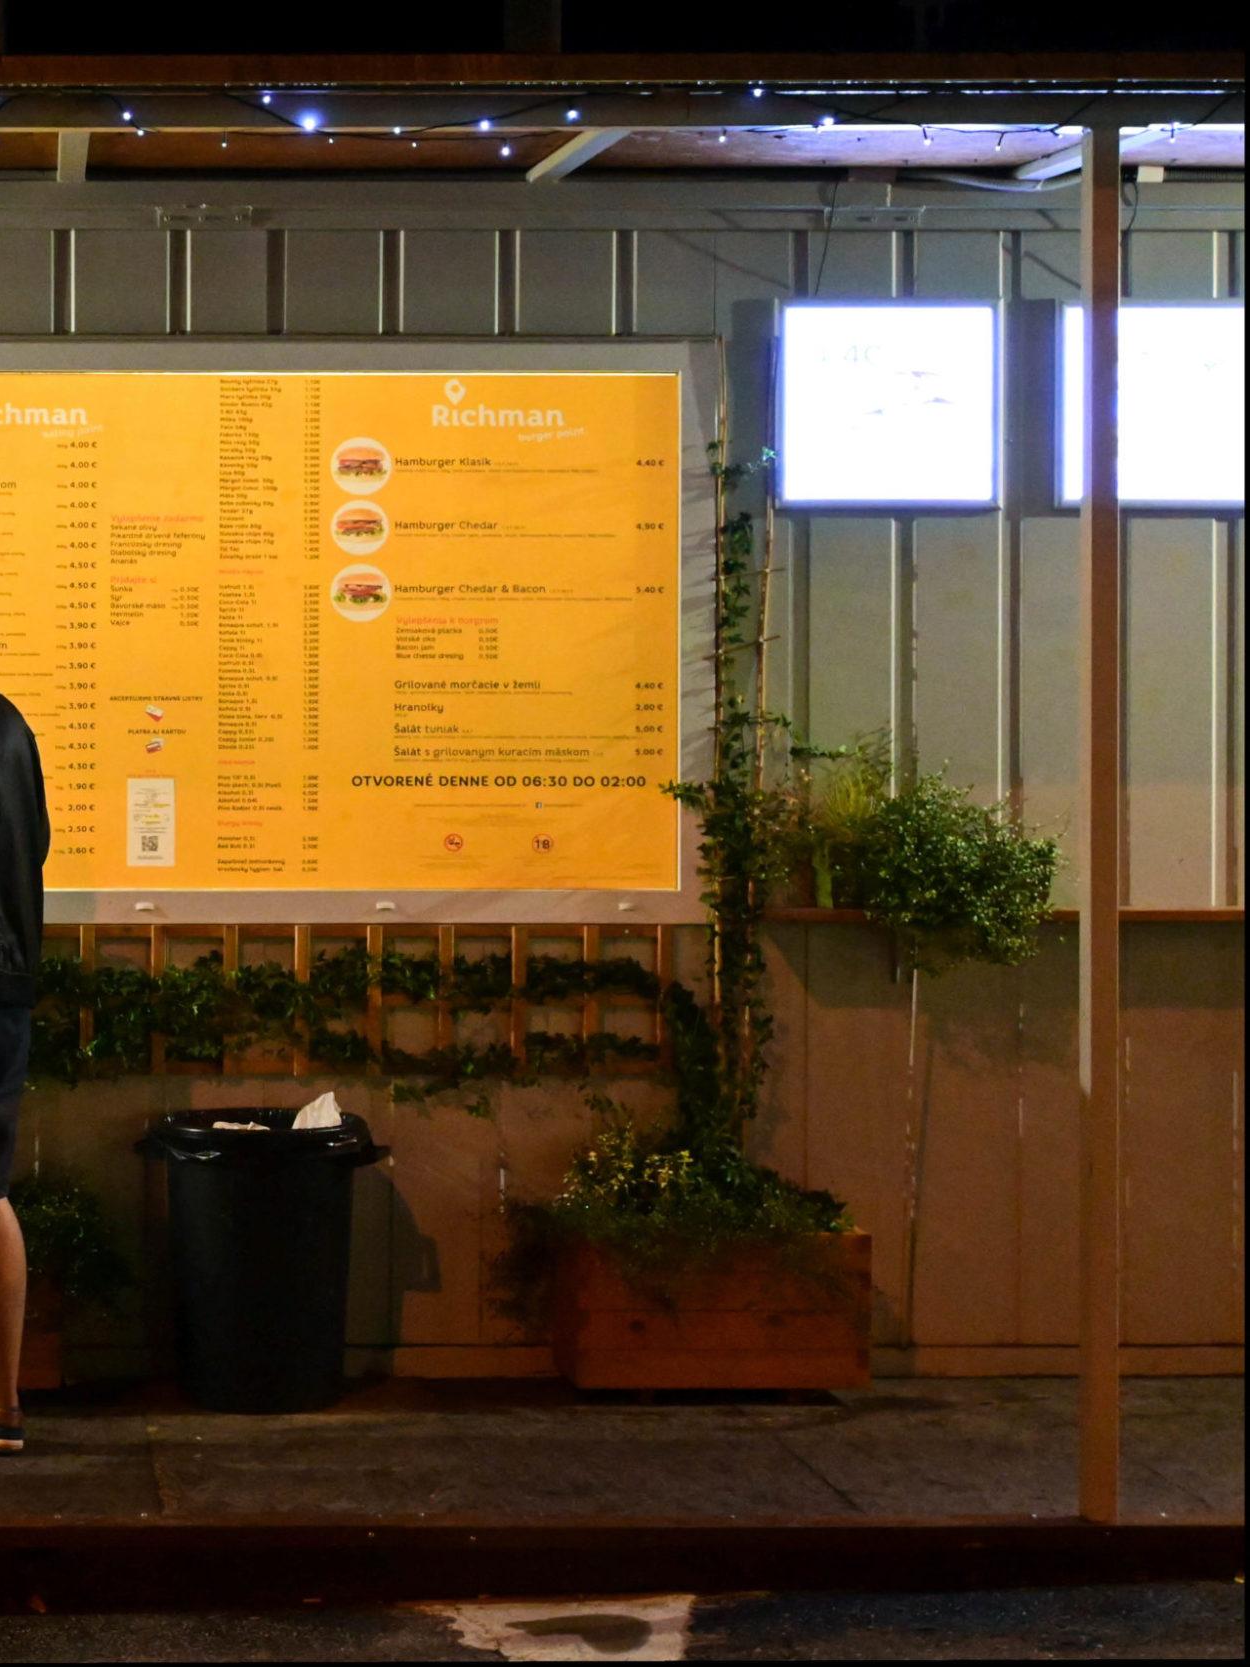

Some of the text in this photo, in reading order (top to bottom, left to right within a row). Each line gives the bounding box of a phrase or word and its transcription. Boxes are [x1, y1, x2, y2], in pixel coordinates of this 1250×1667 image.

[432, 404, 565, 427] Richman
[395, 457, 492, 469] Hamburger Klasik
[394, 520, 497, 533] Hamburger Chedar
[394, 584, 546, 596] Hamburger Chedar & Bacon
[394, 678, 446, 689] Grilované
[394, 703, 444, 714] Hranolky
[424, 724, 459, 733] tuniak
[424, 748, 430, 756] s
[352, 773, 646, 787] OTVORENÉ DENNE OD 06:30 DO 02:00
[535, 839, 551, 850] 18
